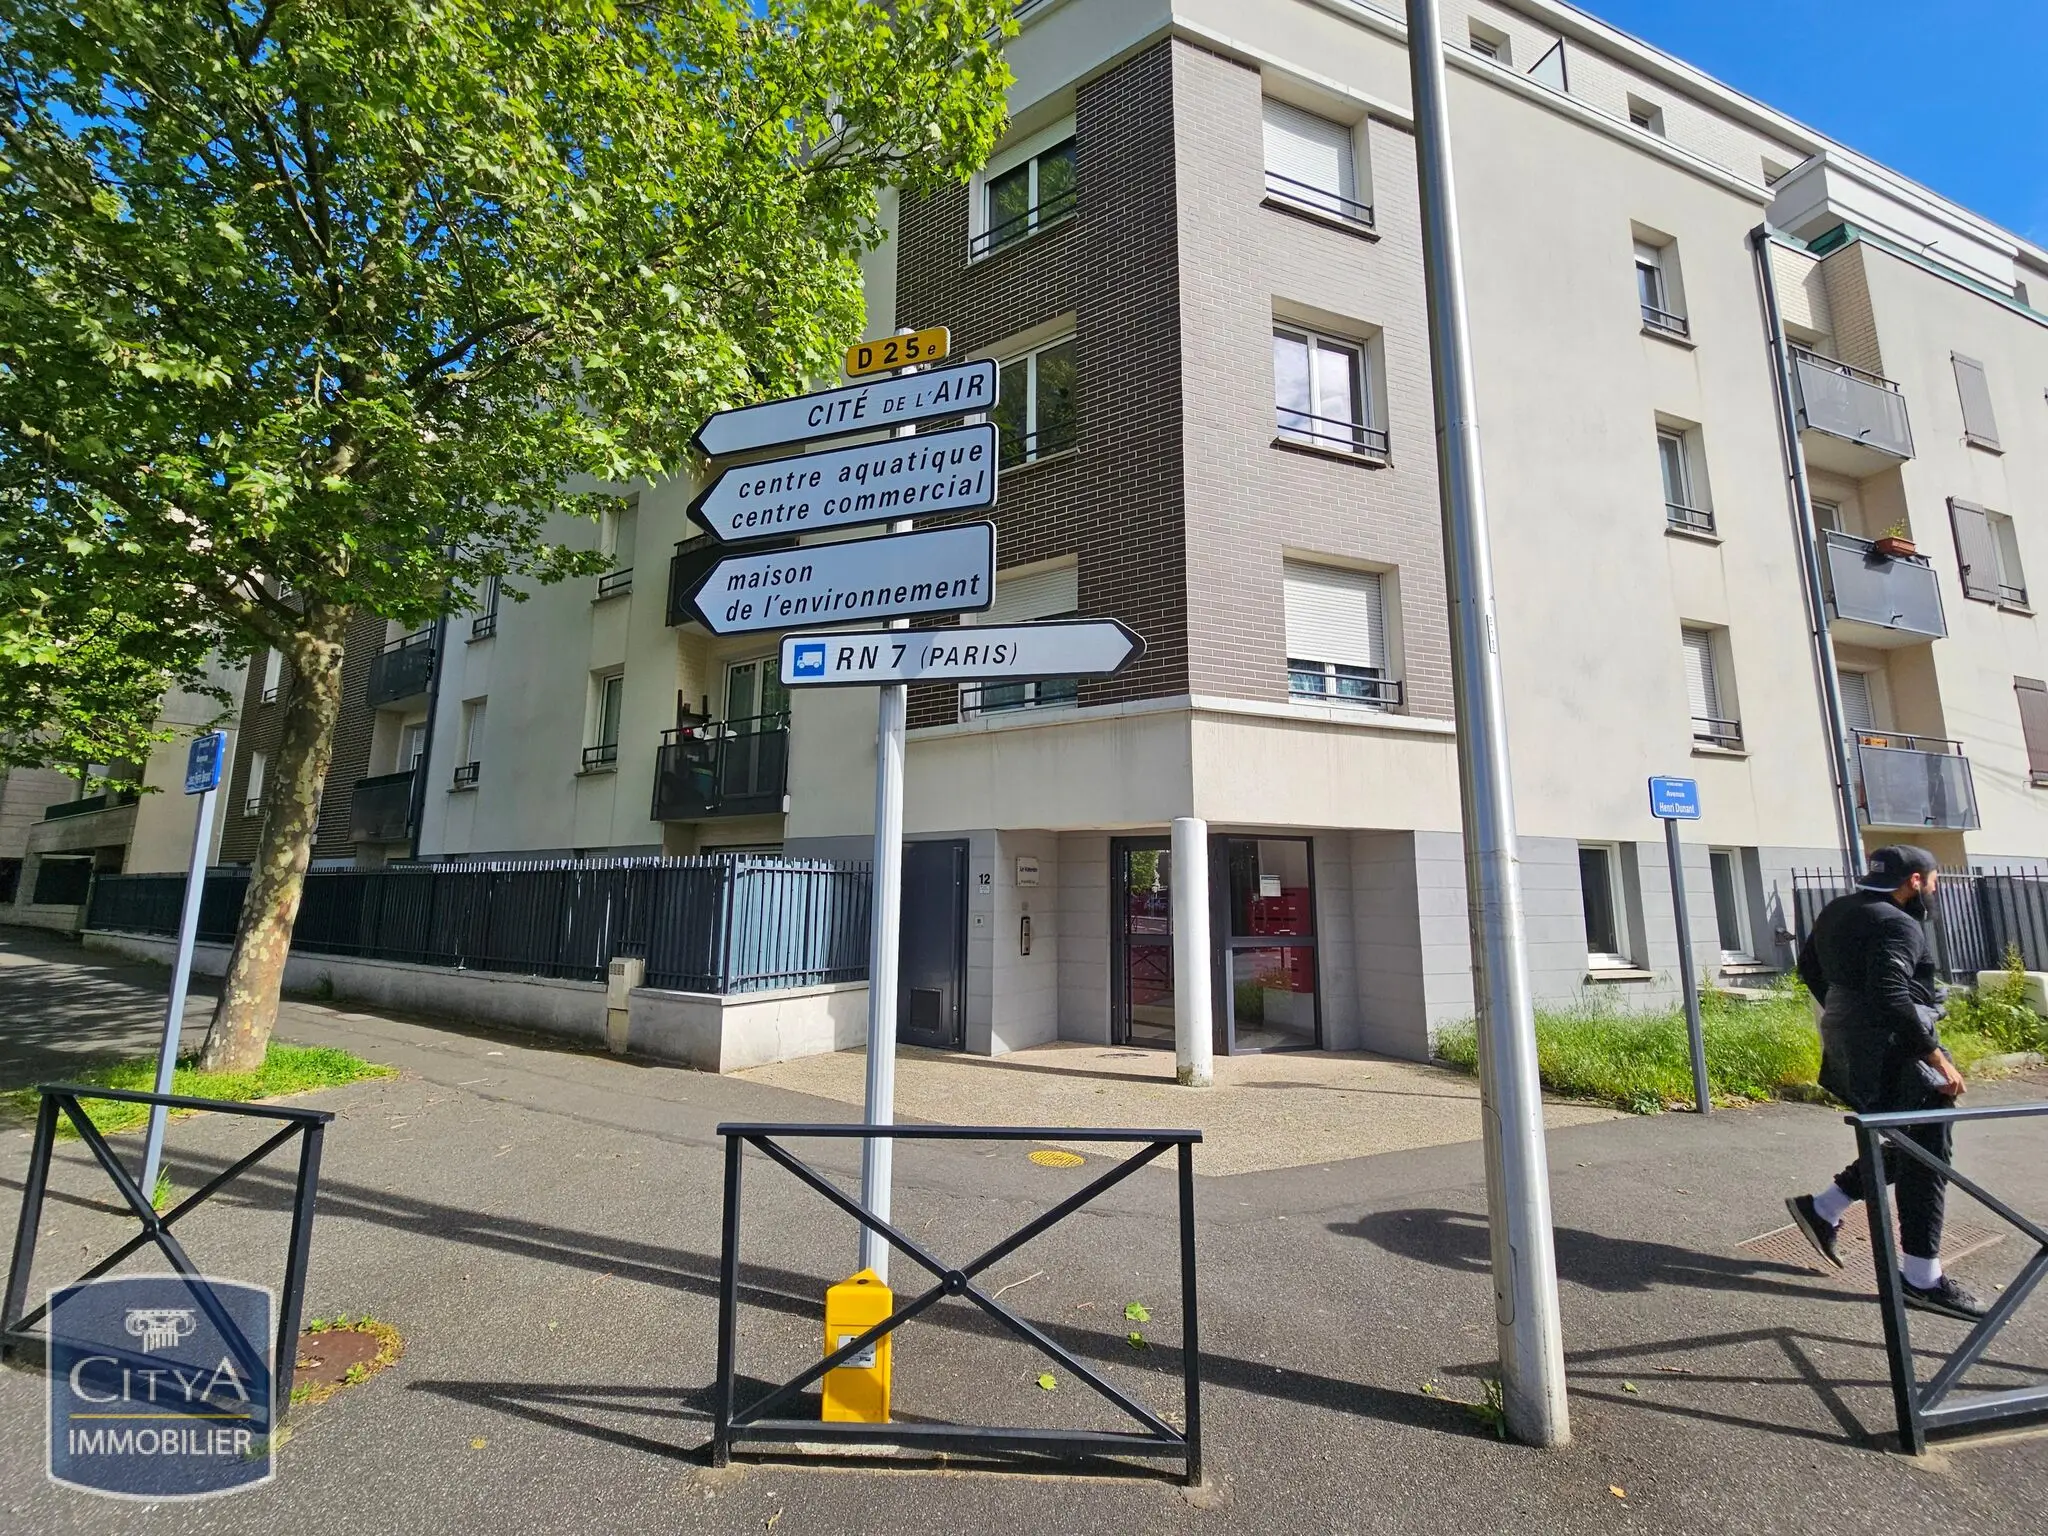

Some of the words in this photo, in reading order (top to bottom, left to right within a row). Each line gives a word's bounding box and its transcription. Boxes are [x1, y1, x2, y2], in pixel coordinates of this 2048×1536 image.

[858, 347, 873, 369] D
[807, 388, 869, 428] CITÉ
[882, 396, 906, 414] DE
[738, 471, 821, 499] centre
[838, 443, 983, 486] aquatique
[732, 503, 810, 529] centre
[823, 470, 985, 516] commercial
[726, 564, 813, 592] maison
[725, 600, 752, 622] de
[764, 574, 981, 618] l'environnement
[836, 646, 878, 671] RN
[891, 644, 907, 669] 7
[920, 642, 1018, 670] (PARIS)
[979, 873, 991, 885] 12
